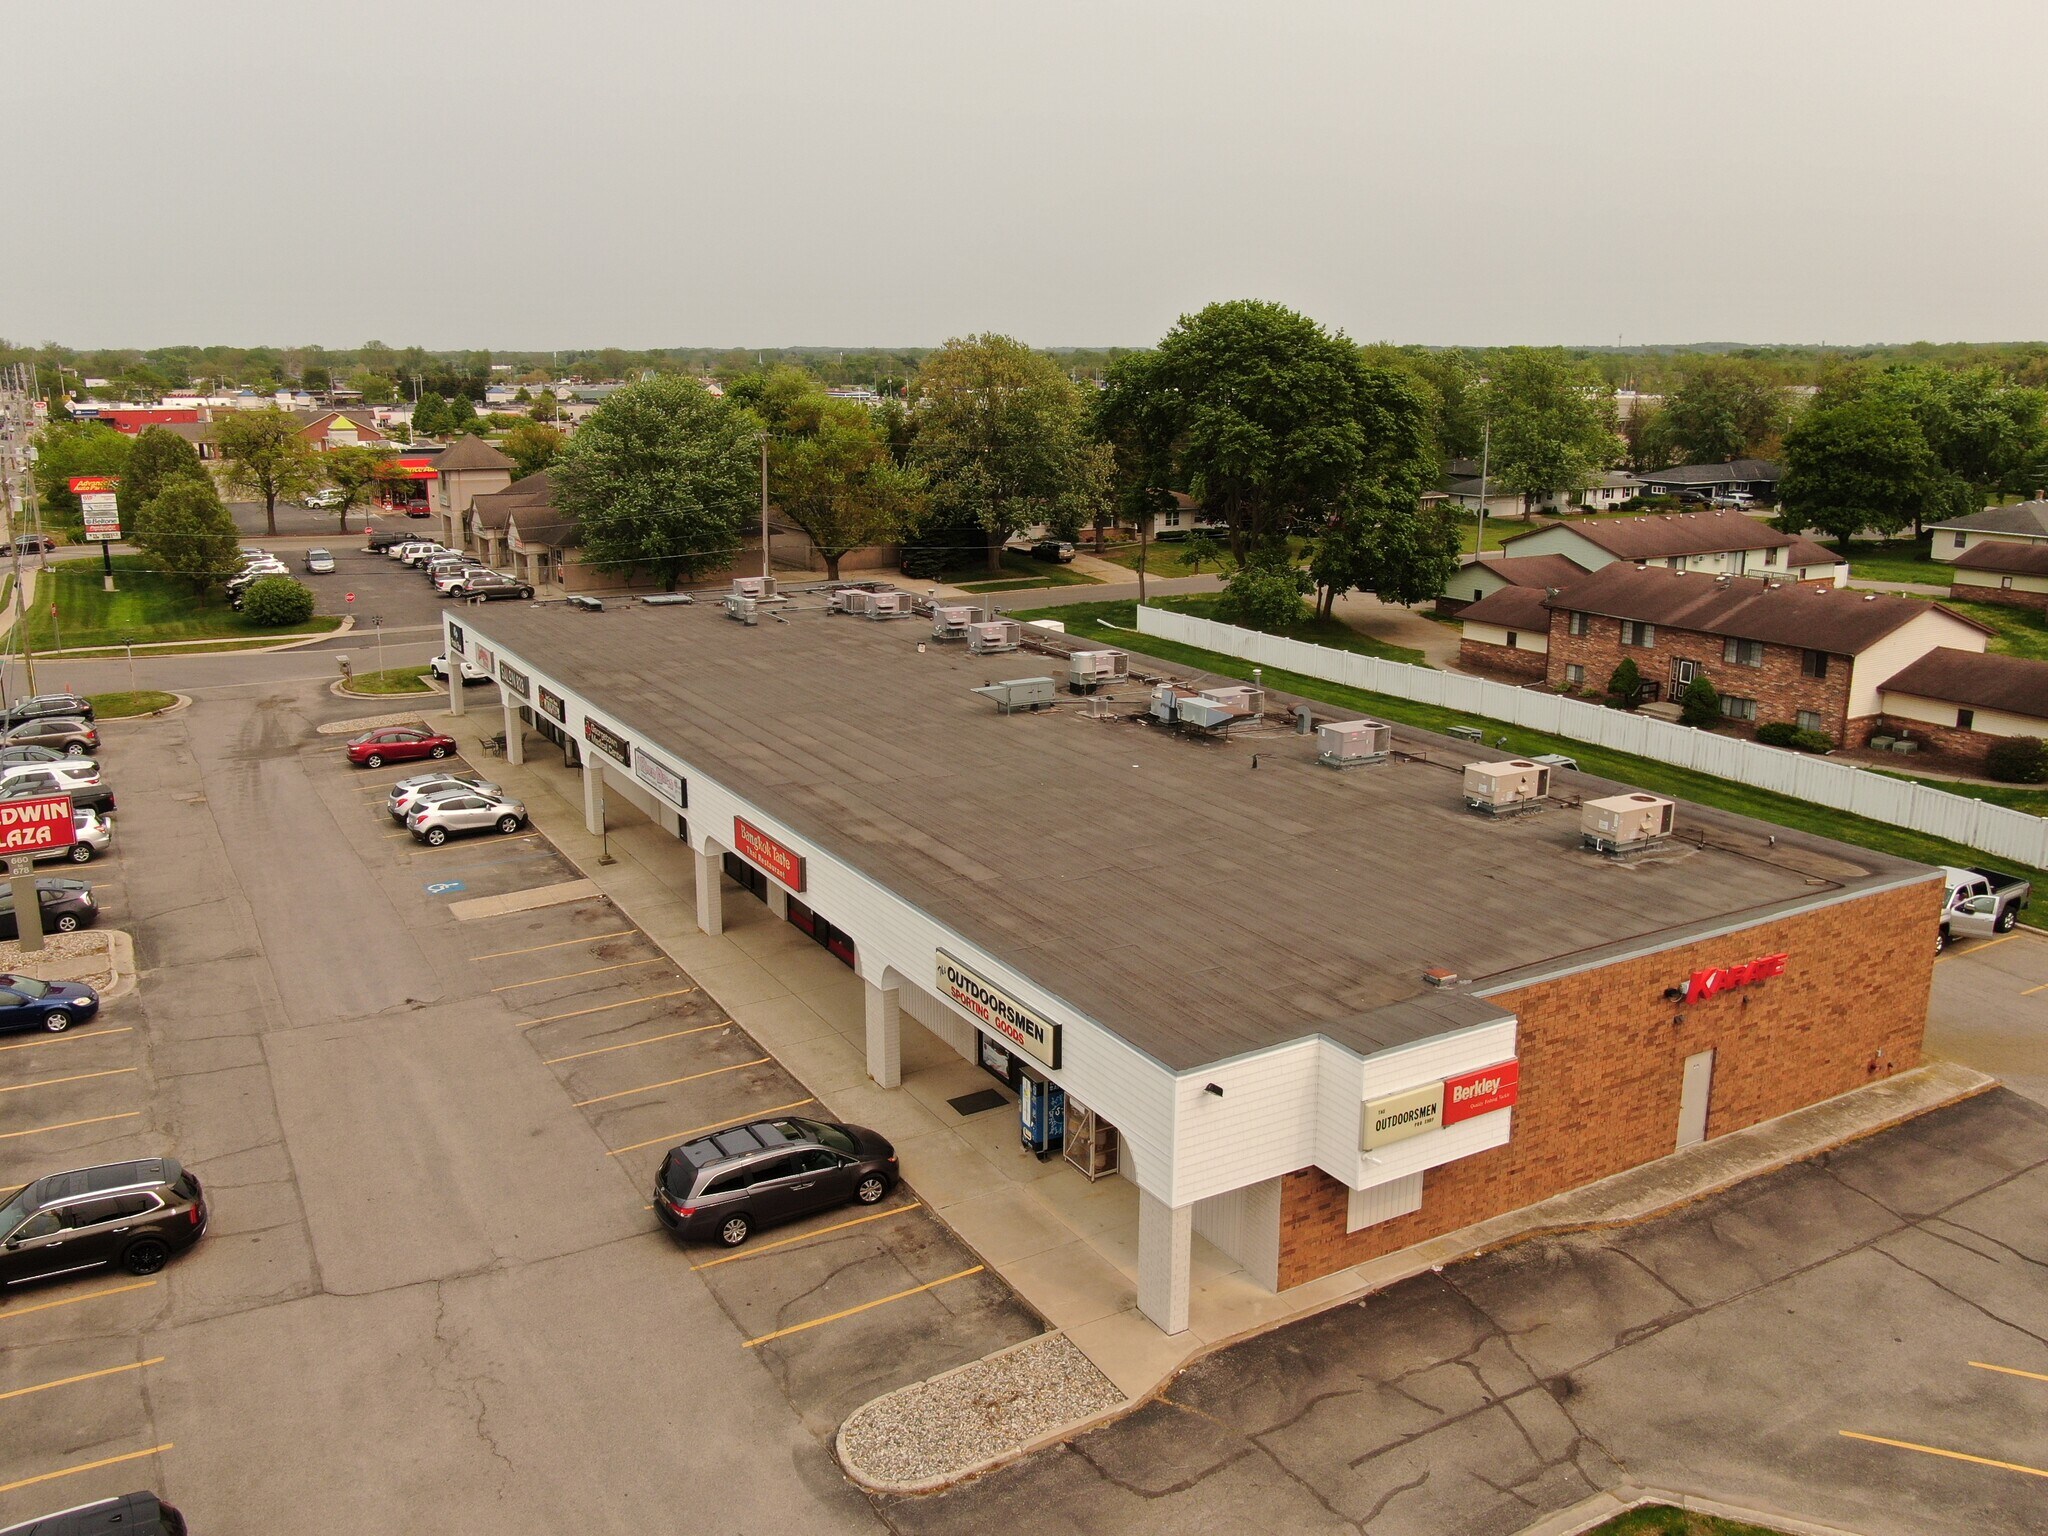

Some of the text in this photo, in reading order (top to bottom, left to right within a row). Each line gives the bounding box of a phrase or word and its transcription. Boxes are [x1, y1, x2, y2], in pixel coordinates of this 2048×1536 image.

[590, 724, 618, 749] Georgetown
[591, 734, 625, 762] Medical Center
[0, 803, 68, 825] DWIN
[741, 824, 791, 870] Bangkok Taste
[13, 867, 30, 875] 678
[746, 846, 786, 880] Thai Restaurant
[1686, 953, 1788, 1005] KARATE
[947, 966, 1044, 1044] OUTDOORSMEN
[951, 986, 1025, 1046] SPORTING GOODS
[1453, 1076, 1501, 1104] Berkley
[1376, 1102, 1437, 1132] OUTDOORSMEN
